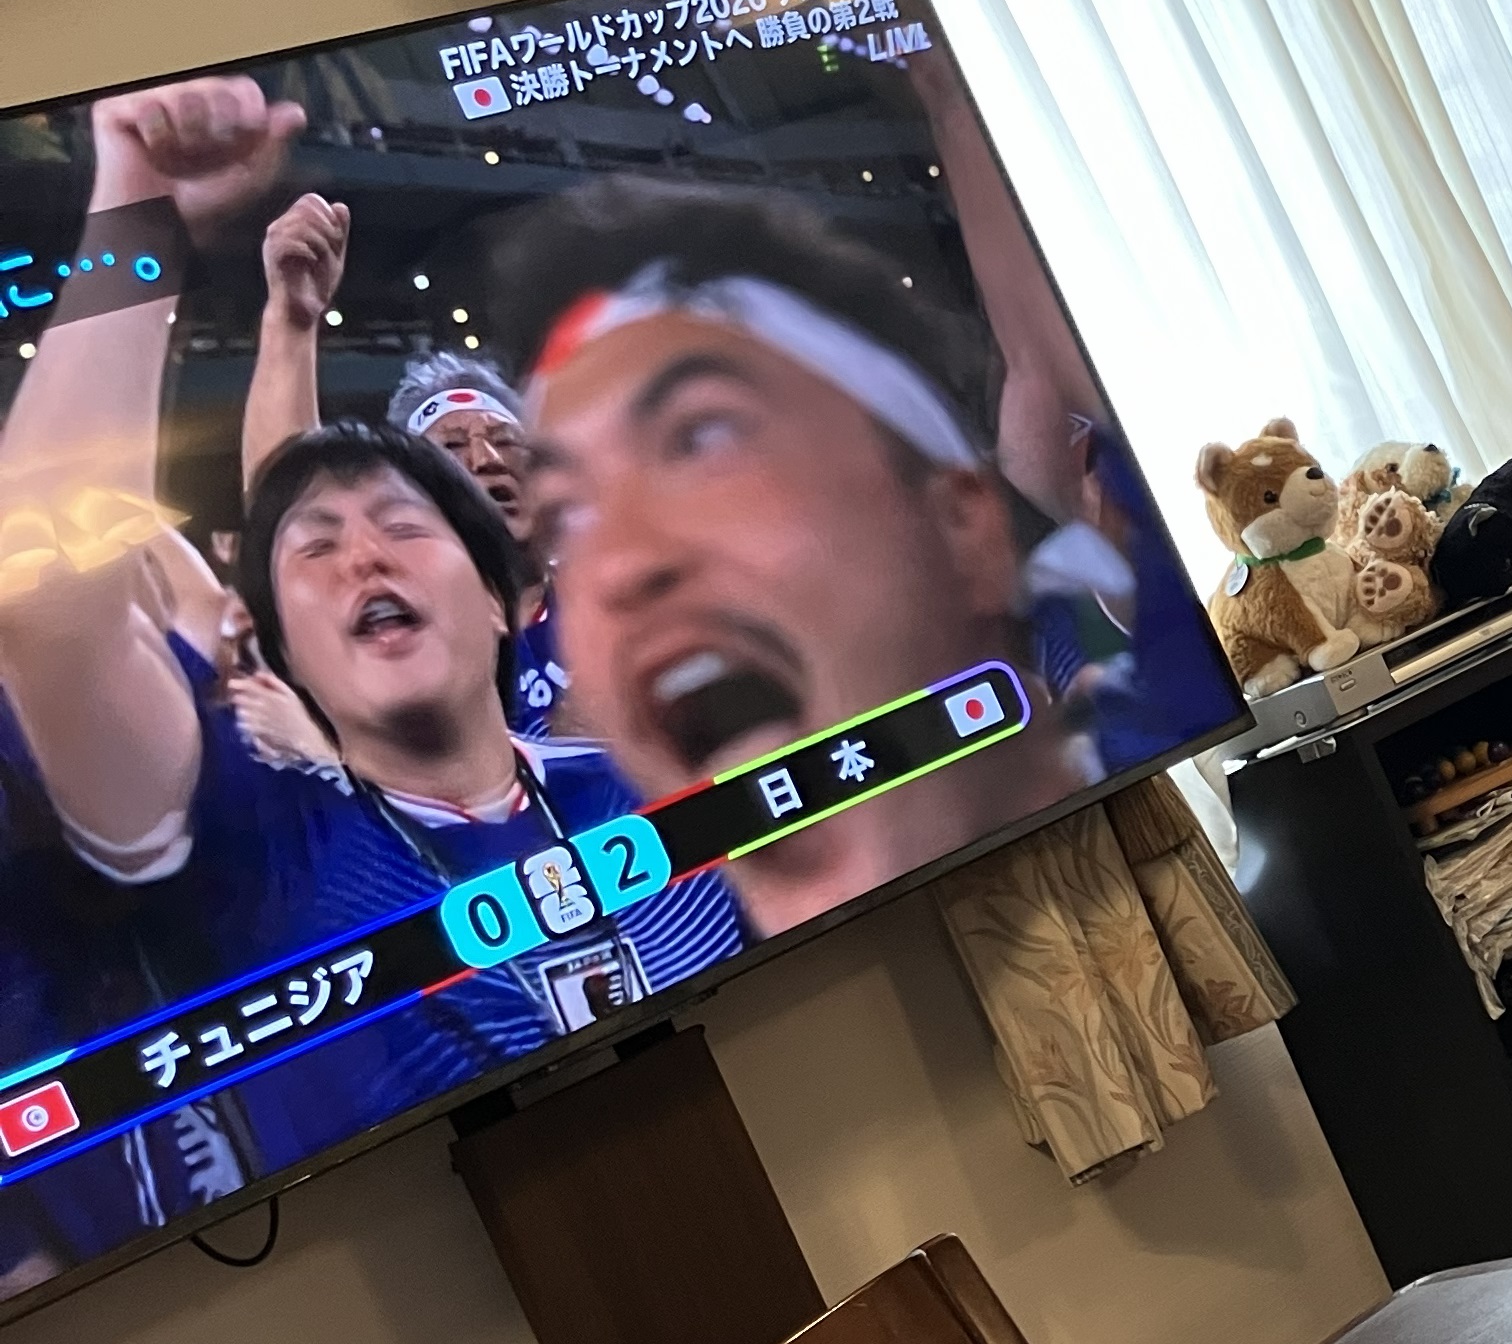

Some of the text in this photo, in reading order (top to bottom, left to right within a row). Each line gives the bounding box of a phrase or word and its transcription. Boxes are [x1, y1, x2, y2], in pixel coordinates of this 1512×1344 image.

[508, 29, 754, 106] 決勝トーナメントへ
[602, 834, 651, 893] 2
[467, 892, 512, 948] 0
[560, 907, 583, 924] FIFA
[141, 950, 374, 1088] チュニジア
